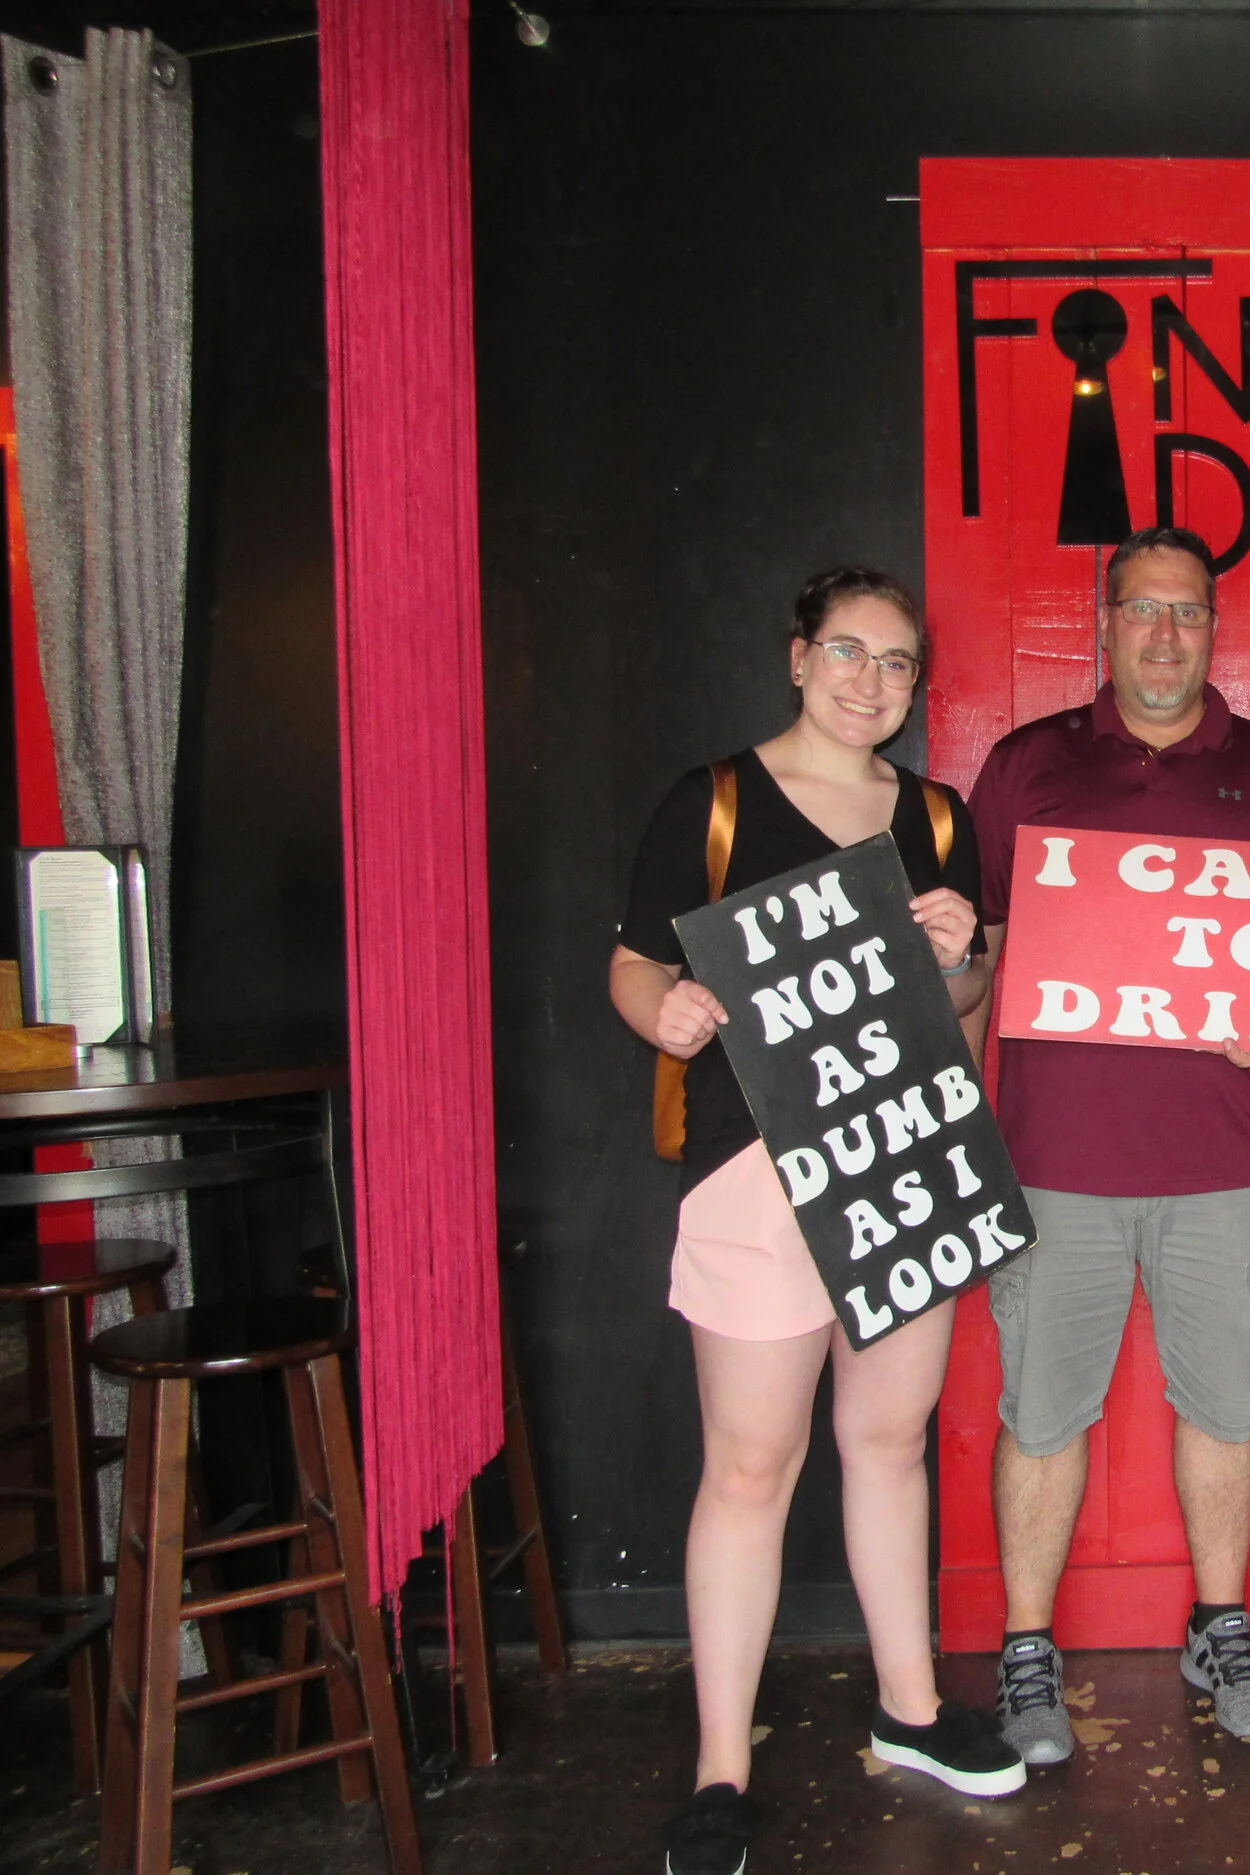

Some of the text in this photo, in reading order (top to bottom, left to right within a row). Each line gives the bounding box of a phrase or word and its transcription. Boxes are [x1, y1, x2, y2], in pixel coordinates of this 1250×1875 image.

[1035, 837, 1077, 887] I
[733, 871, 859, 965] I'M
[750, 936, 895, 1045] NOT
[810, 1020, 900, 1107] AS
[777, 1065, 980, 1206] DUMB
[844, 1144, 982, 1260] AS I
[845, 1203, 1026, 1340] LOOK
